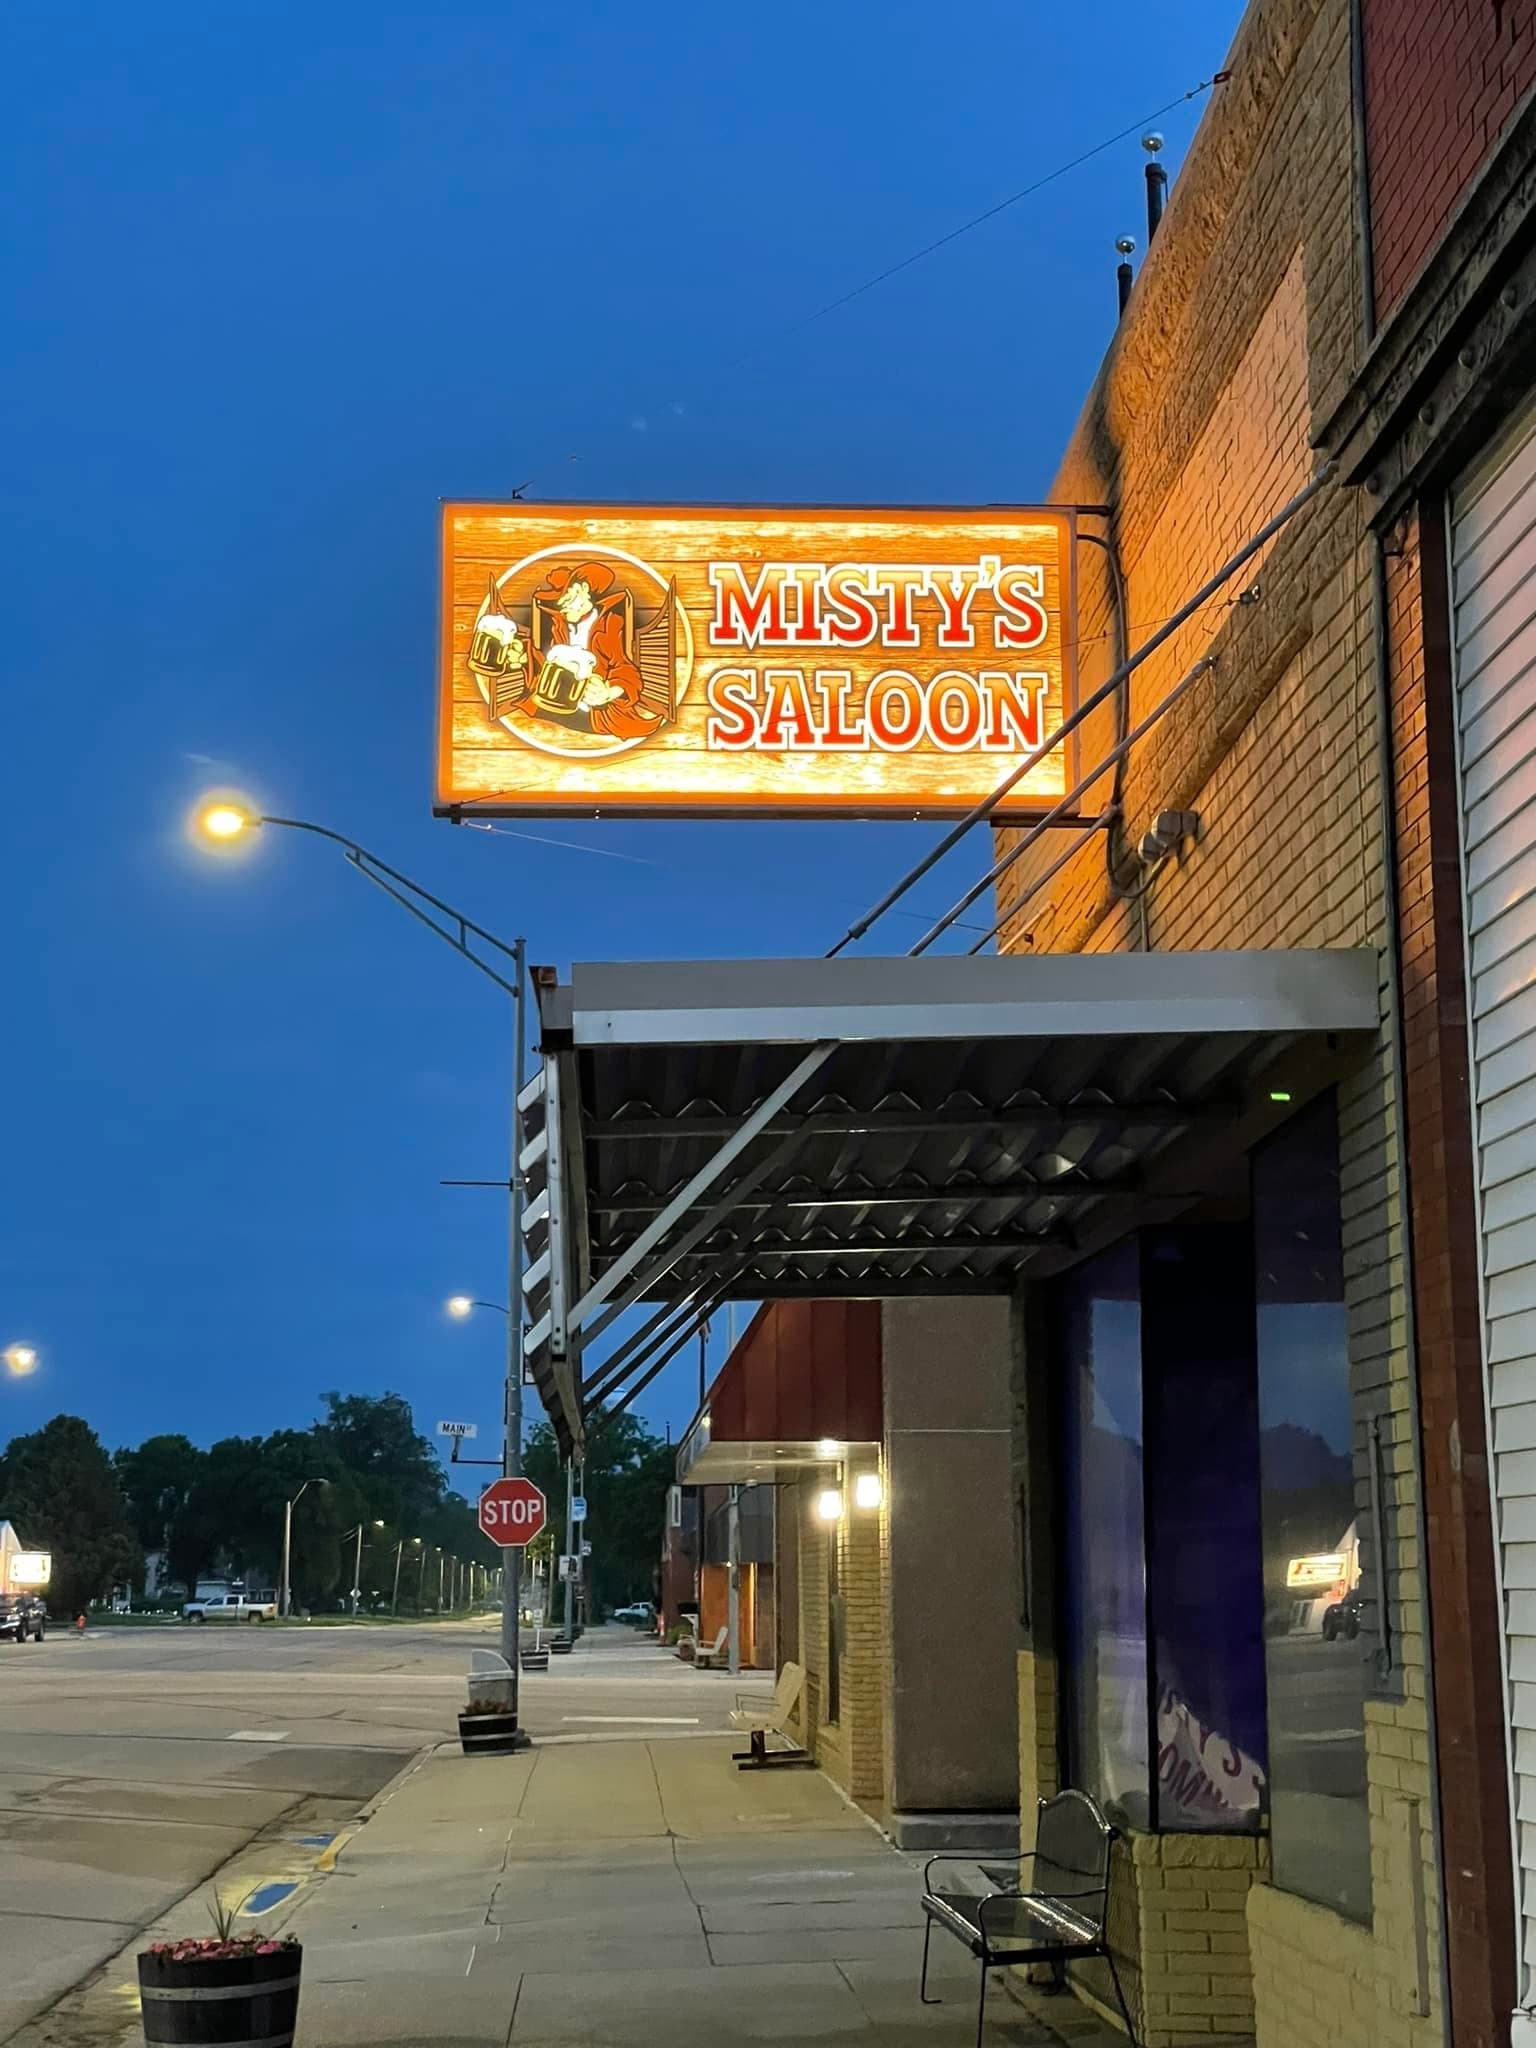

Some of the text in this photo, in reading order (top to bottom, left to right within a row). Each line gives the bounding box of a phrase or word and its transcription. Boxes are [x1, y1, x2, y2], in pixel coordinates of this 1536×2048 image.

[709, 556, 1048, 648] MISTY'S
[707, 668, 1049, 752] SALOON
[443, 1423, 466, 1434] MAIN
[483, 1498, 541, 1526] STOP
